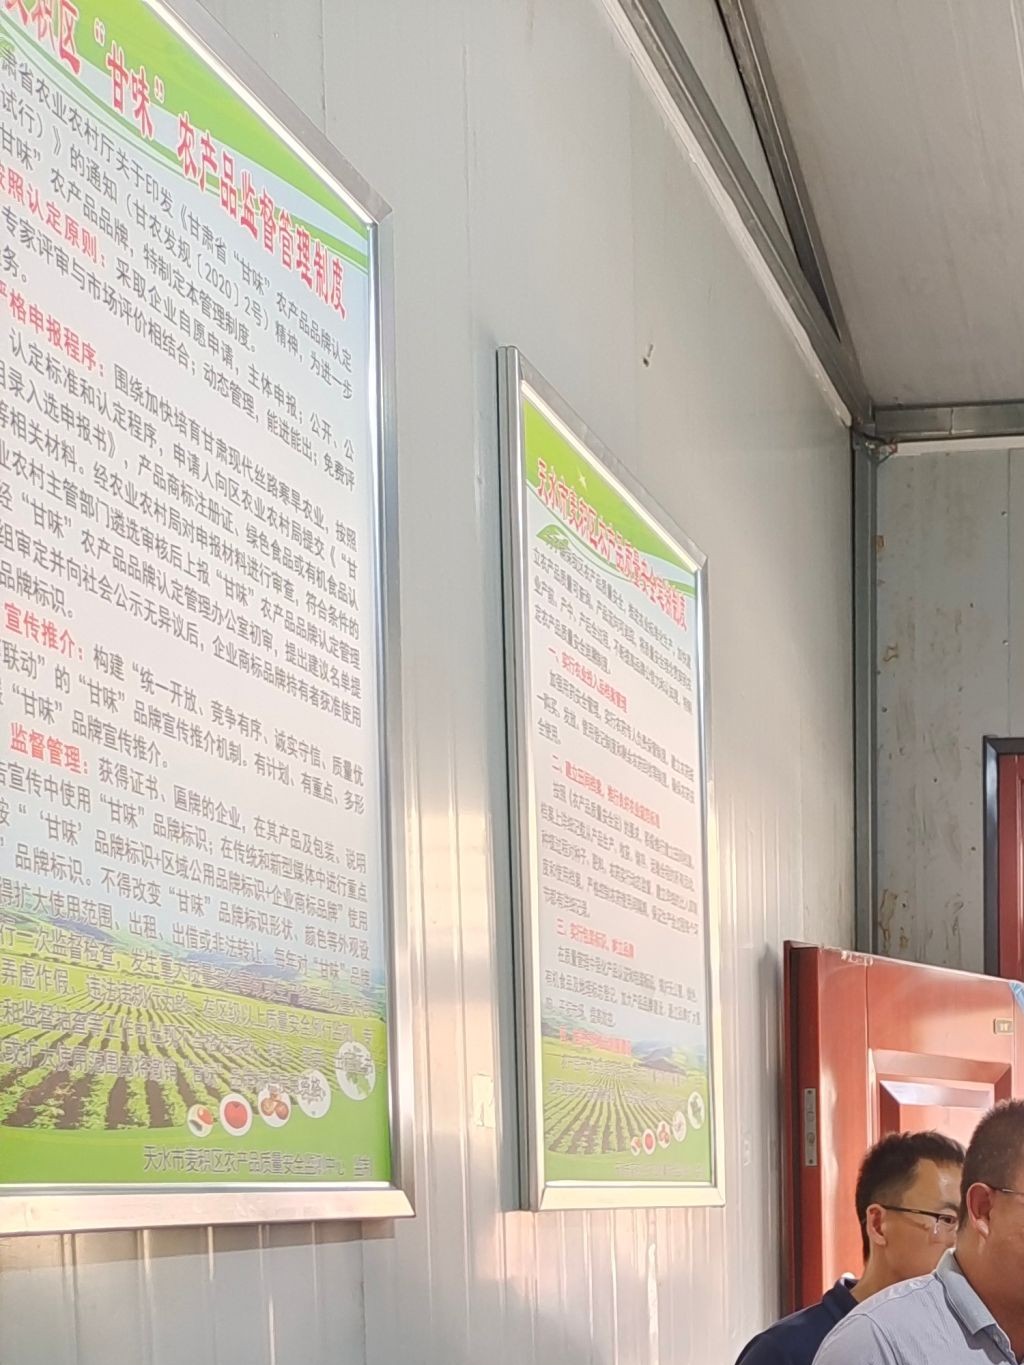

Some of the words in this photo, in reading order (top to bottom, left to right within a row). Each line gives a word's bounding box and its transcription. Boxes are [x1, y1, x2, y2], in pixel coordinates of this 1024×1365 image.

[5, 0, 346, 321] 积区“甘味”农产品监督管理制度
